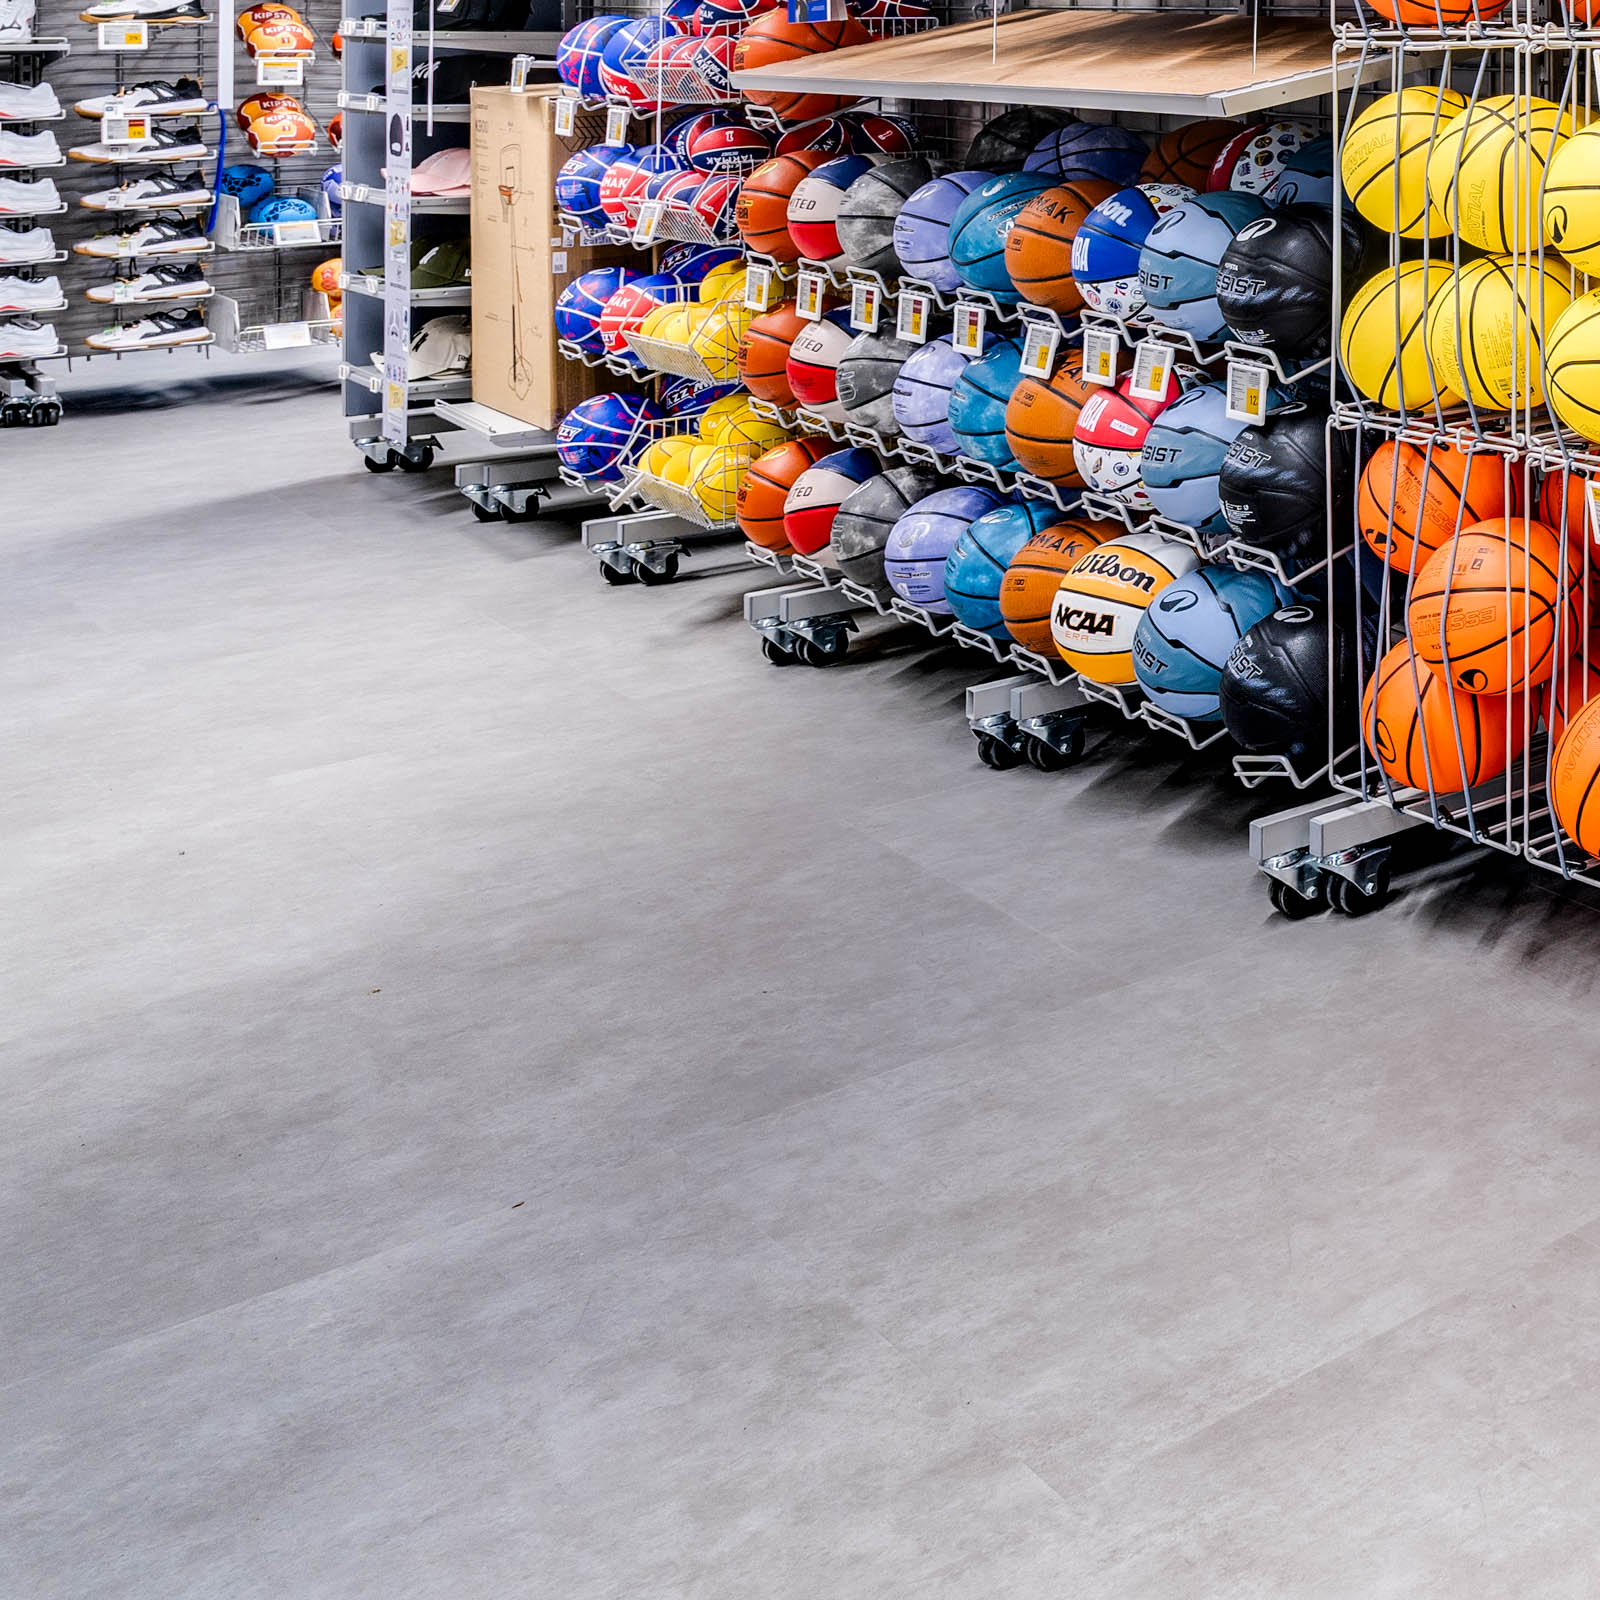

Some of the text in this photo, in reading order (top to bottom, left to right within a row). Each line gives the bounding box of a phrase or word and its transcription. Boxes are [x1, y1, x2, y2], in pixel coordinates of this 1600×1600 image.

[264, 24, 304, 35] KIPSTA
[265, 113, 305, 123] KIPSTA
[1139, 274, 1173, 290] SIST
[1215, 272, 1266, 297] ESIST
[1142, 447, 1182, 463] SIST
[1072, 553, 1155, 596] Wilson
[1055, 603, 1115, 636] NCAA
[1064, 630, 1088, 642] ERA
